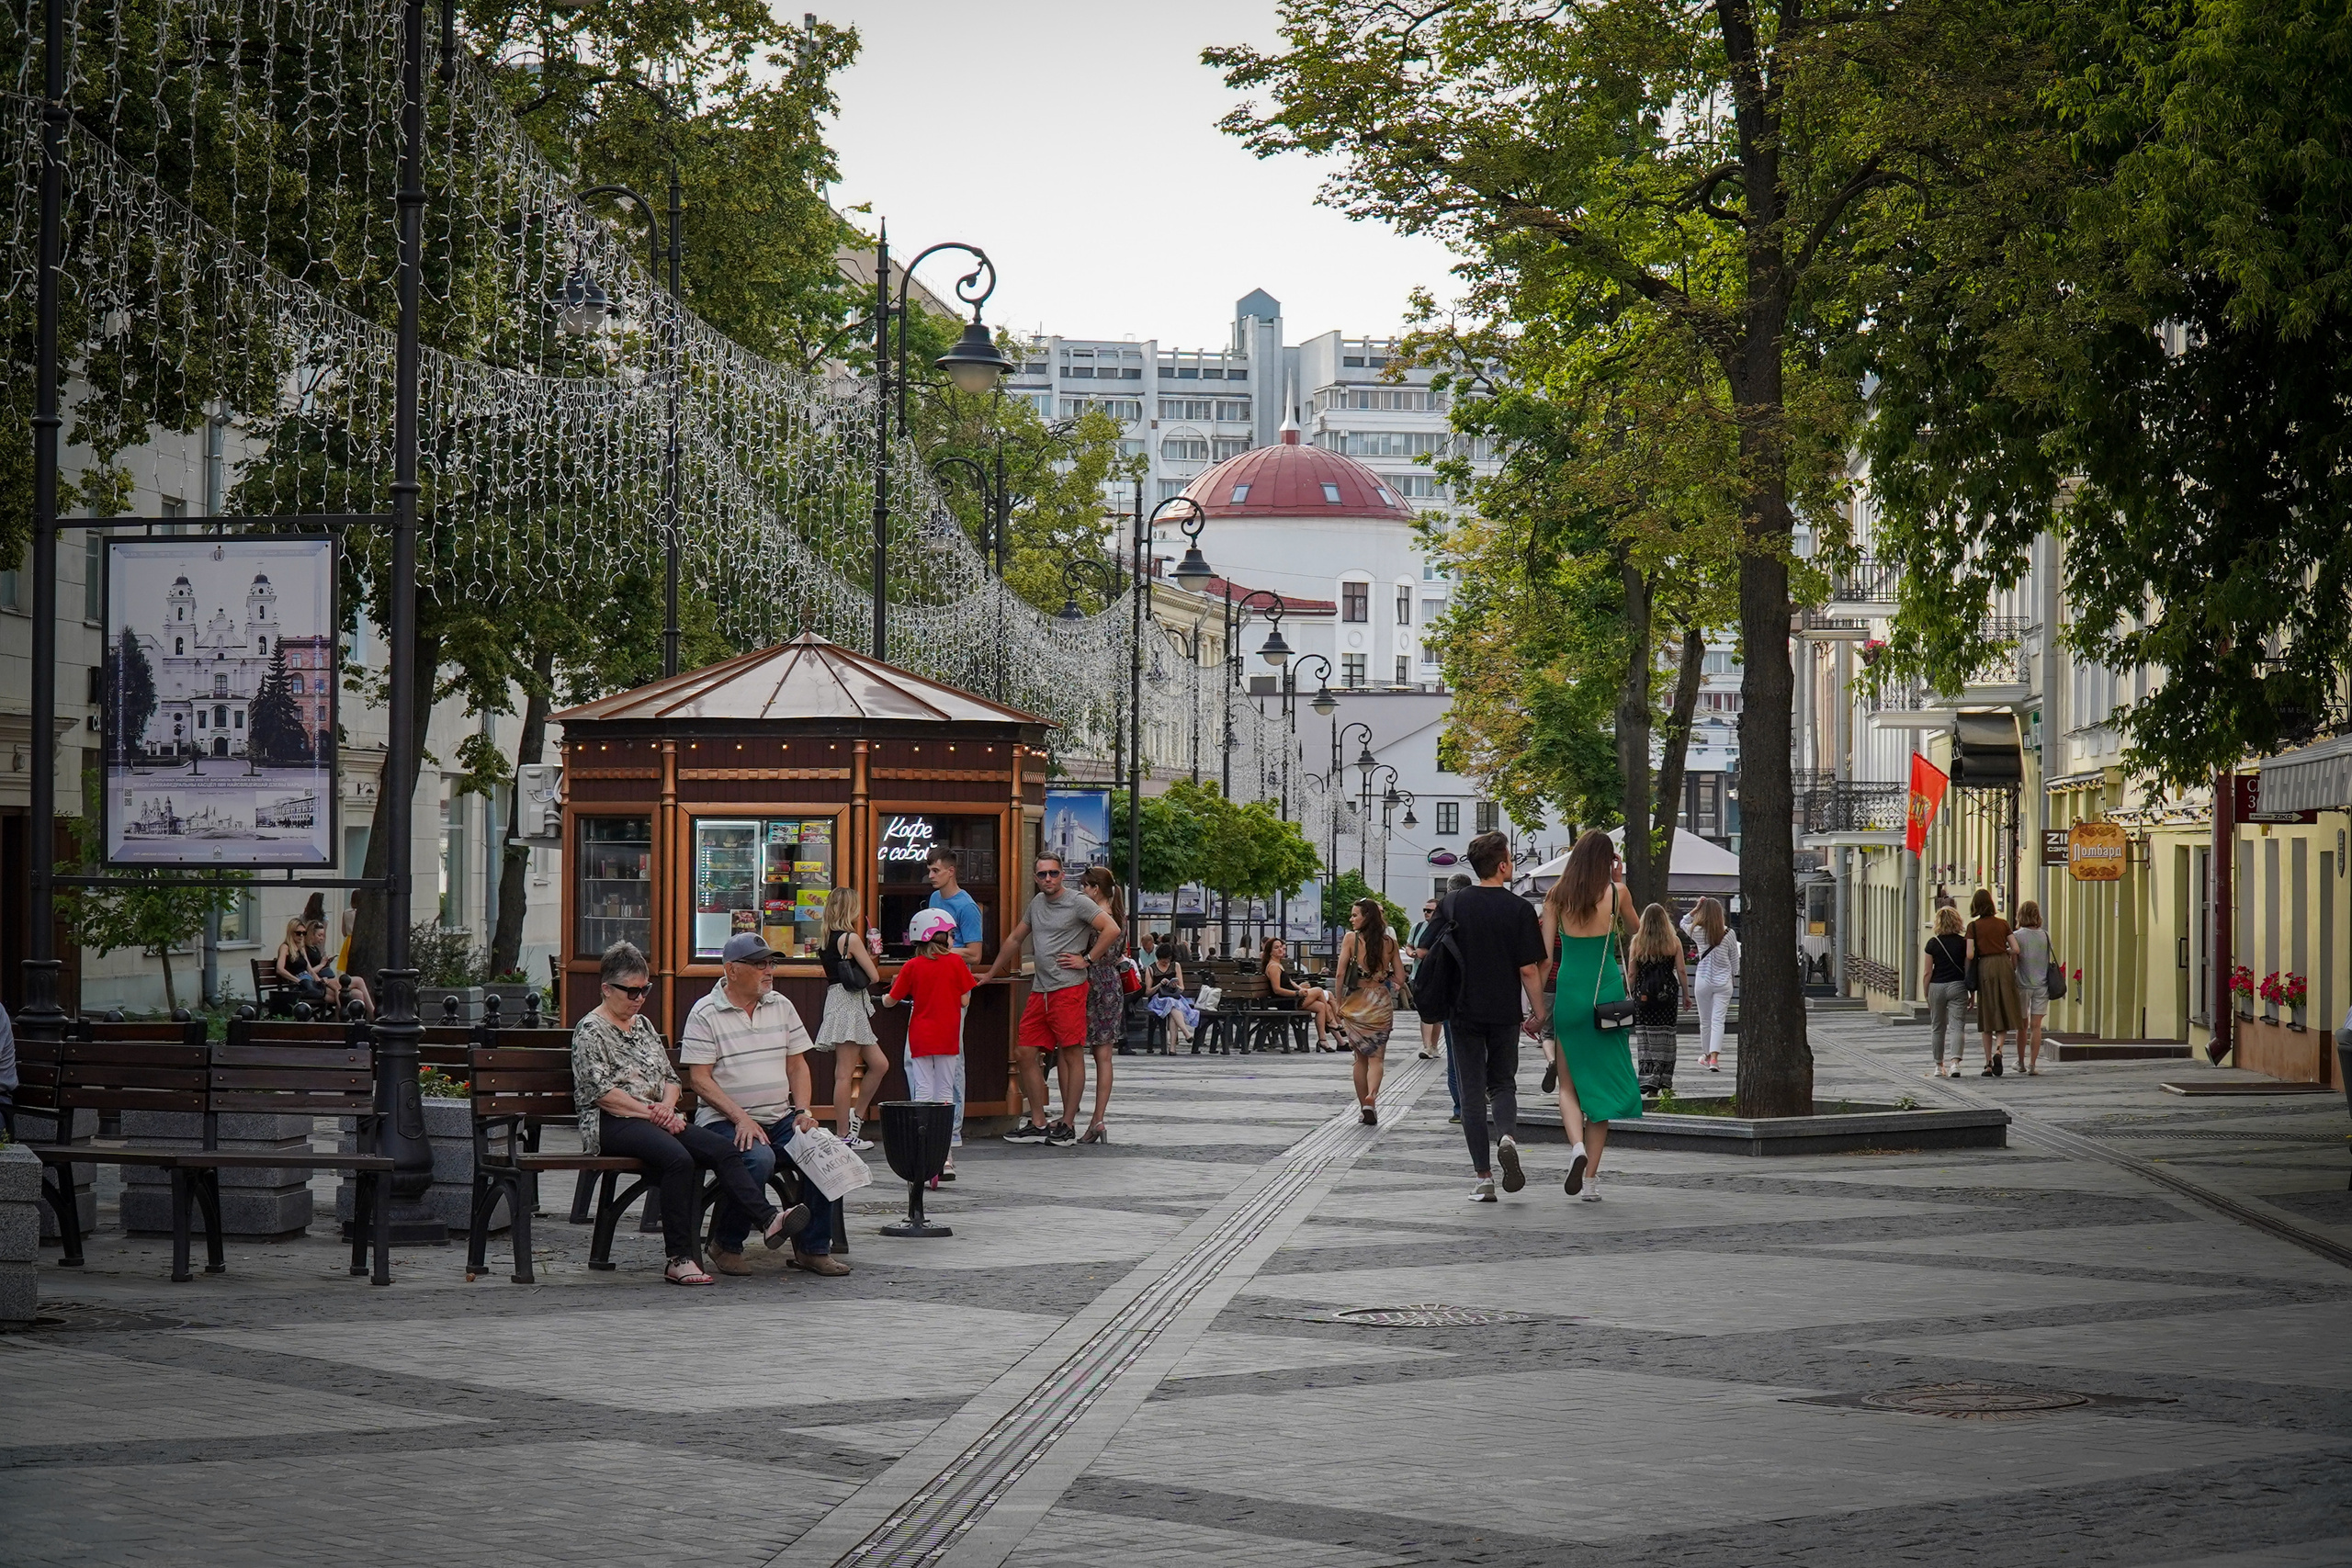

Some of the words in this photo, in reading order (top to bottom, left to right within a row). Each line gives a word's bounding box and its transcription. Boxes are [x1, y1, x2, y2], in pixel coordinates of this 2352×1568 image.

[883, 816, 933, 847] Кофе
[877, 846, 888, 861] с
[2073, 842, 2122, 862] Ломбард
